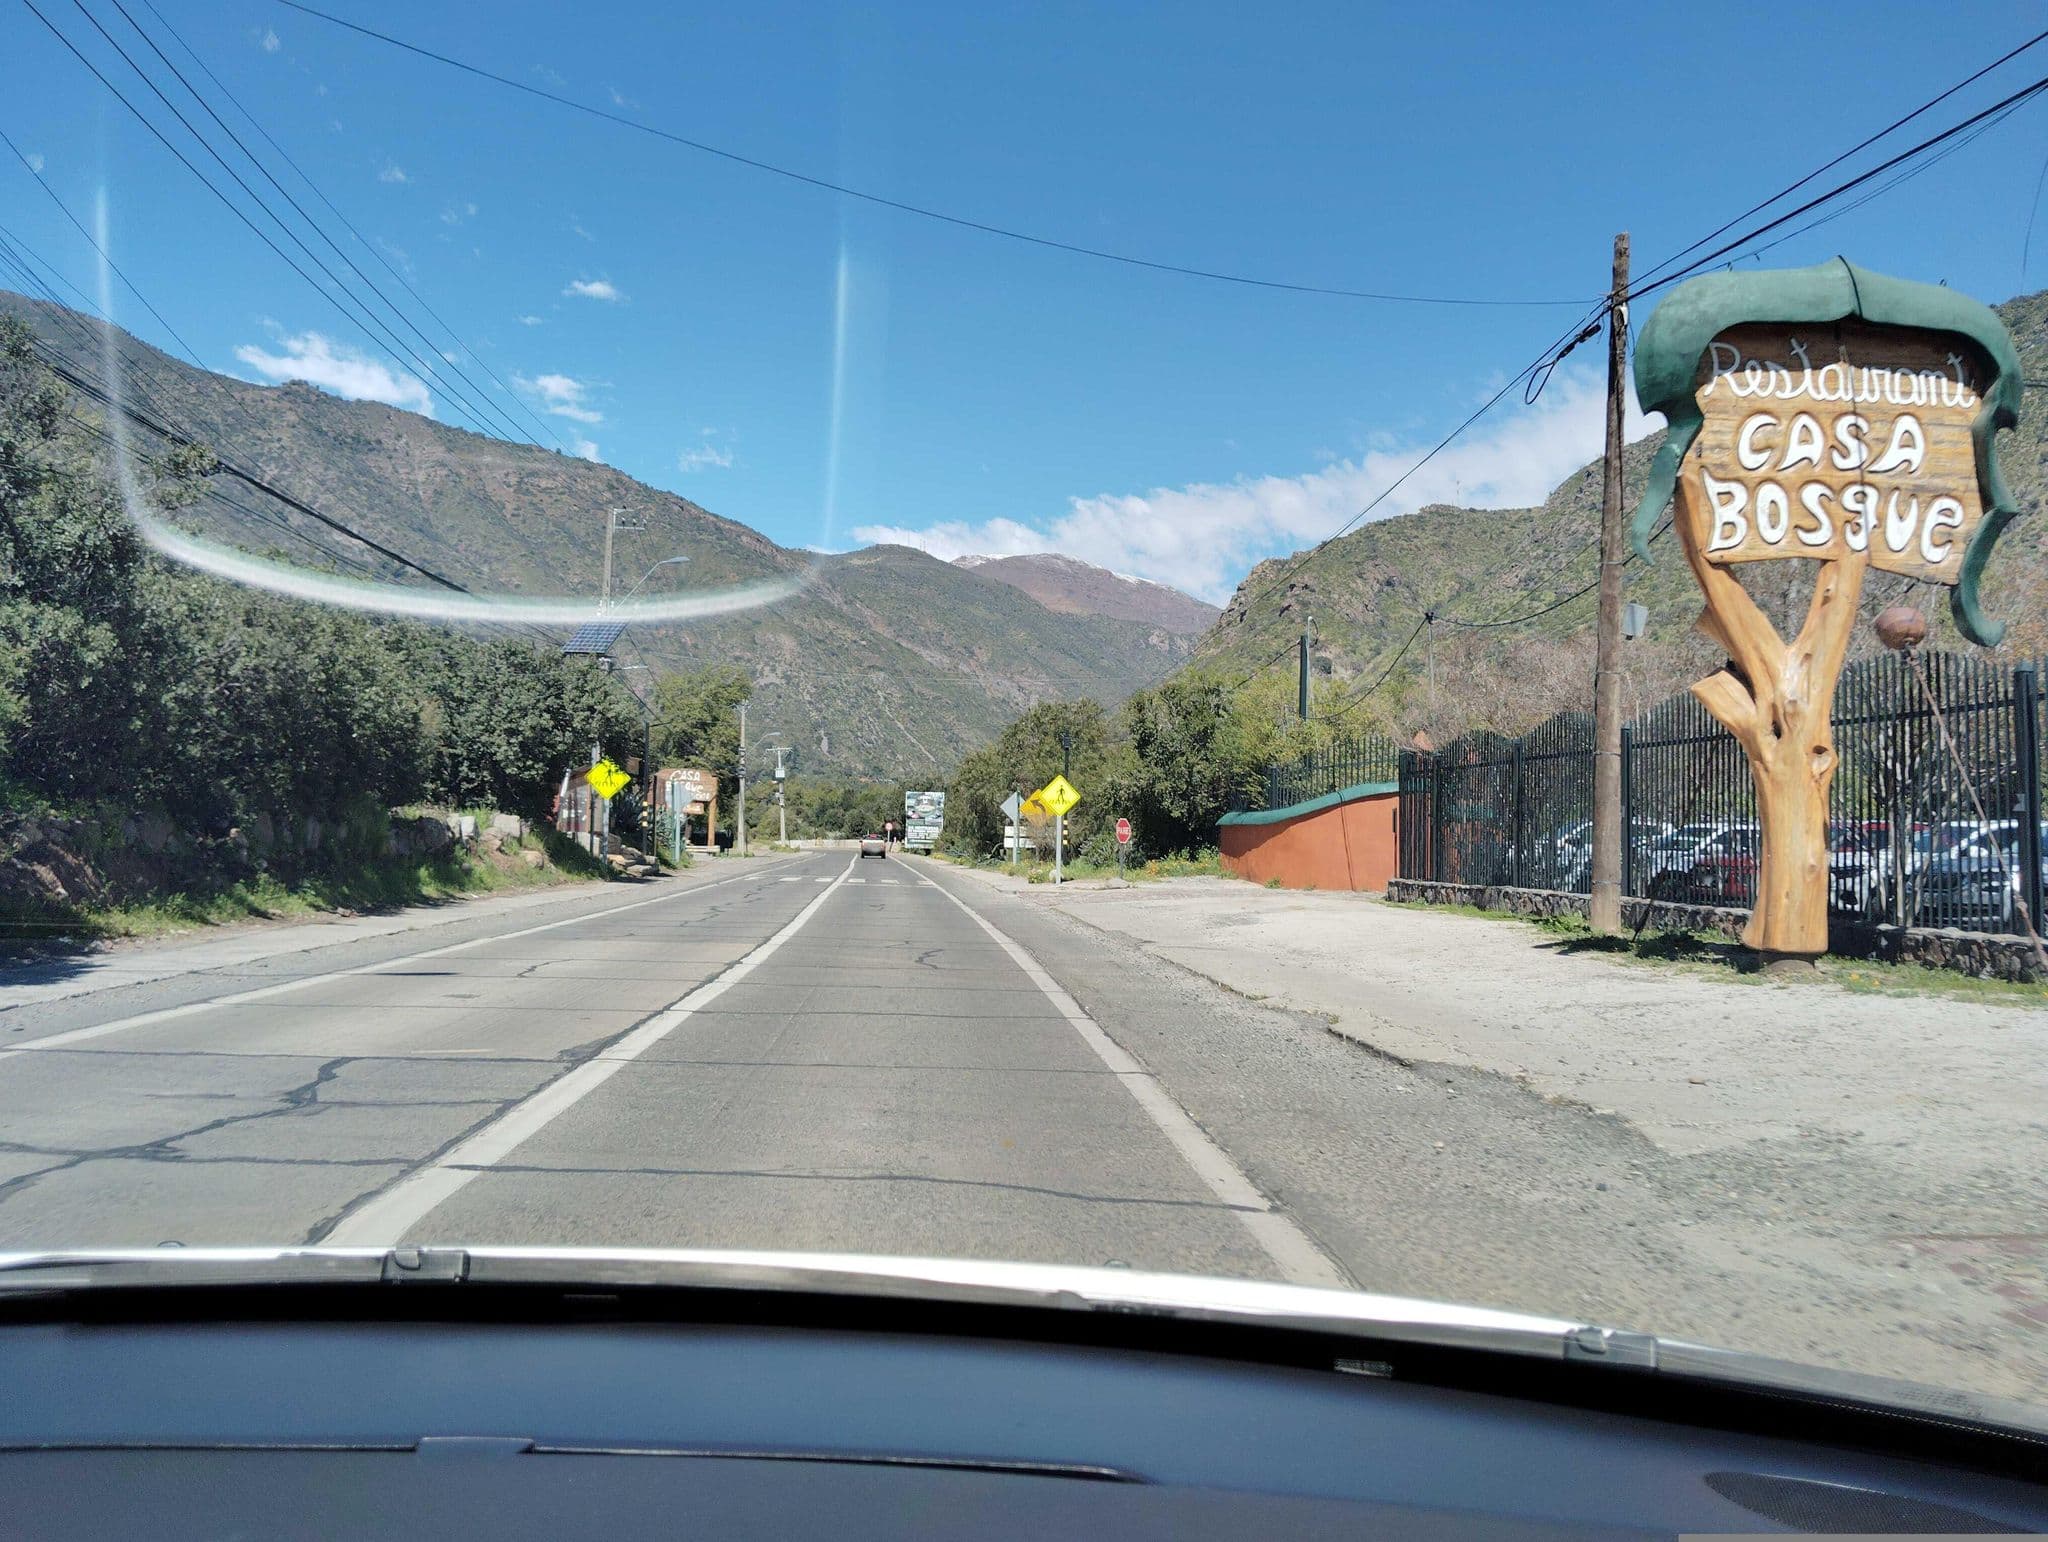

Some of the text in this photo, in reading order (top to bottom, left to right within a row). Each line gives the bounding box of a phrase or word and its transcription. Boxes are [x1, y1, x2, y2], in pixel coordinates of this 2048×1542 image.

[1704, 338, 1977, 408] Restaurant
[1738, 412, 1924, 473] CASA
[670, 770, 701, 781] CASA
